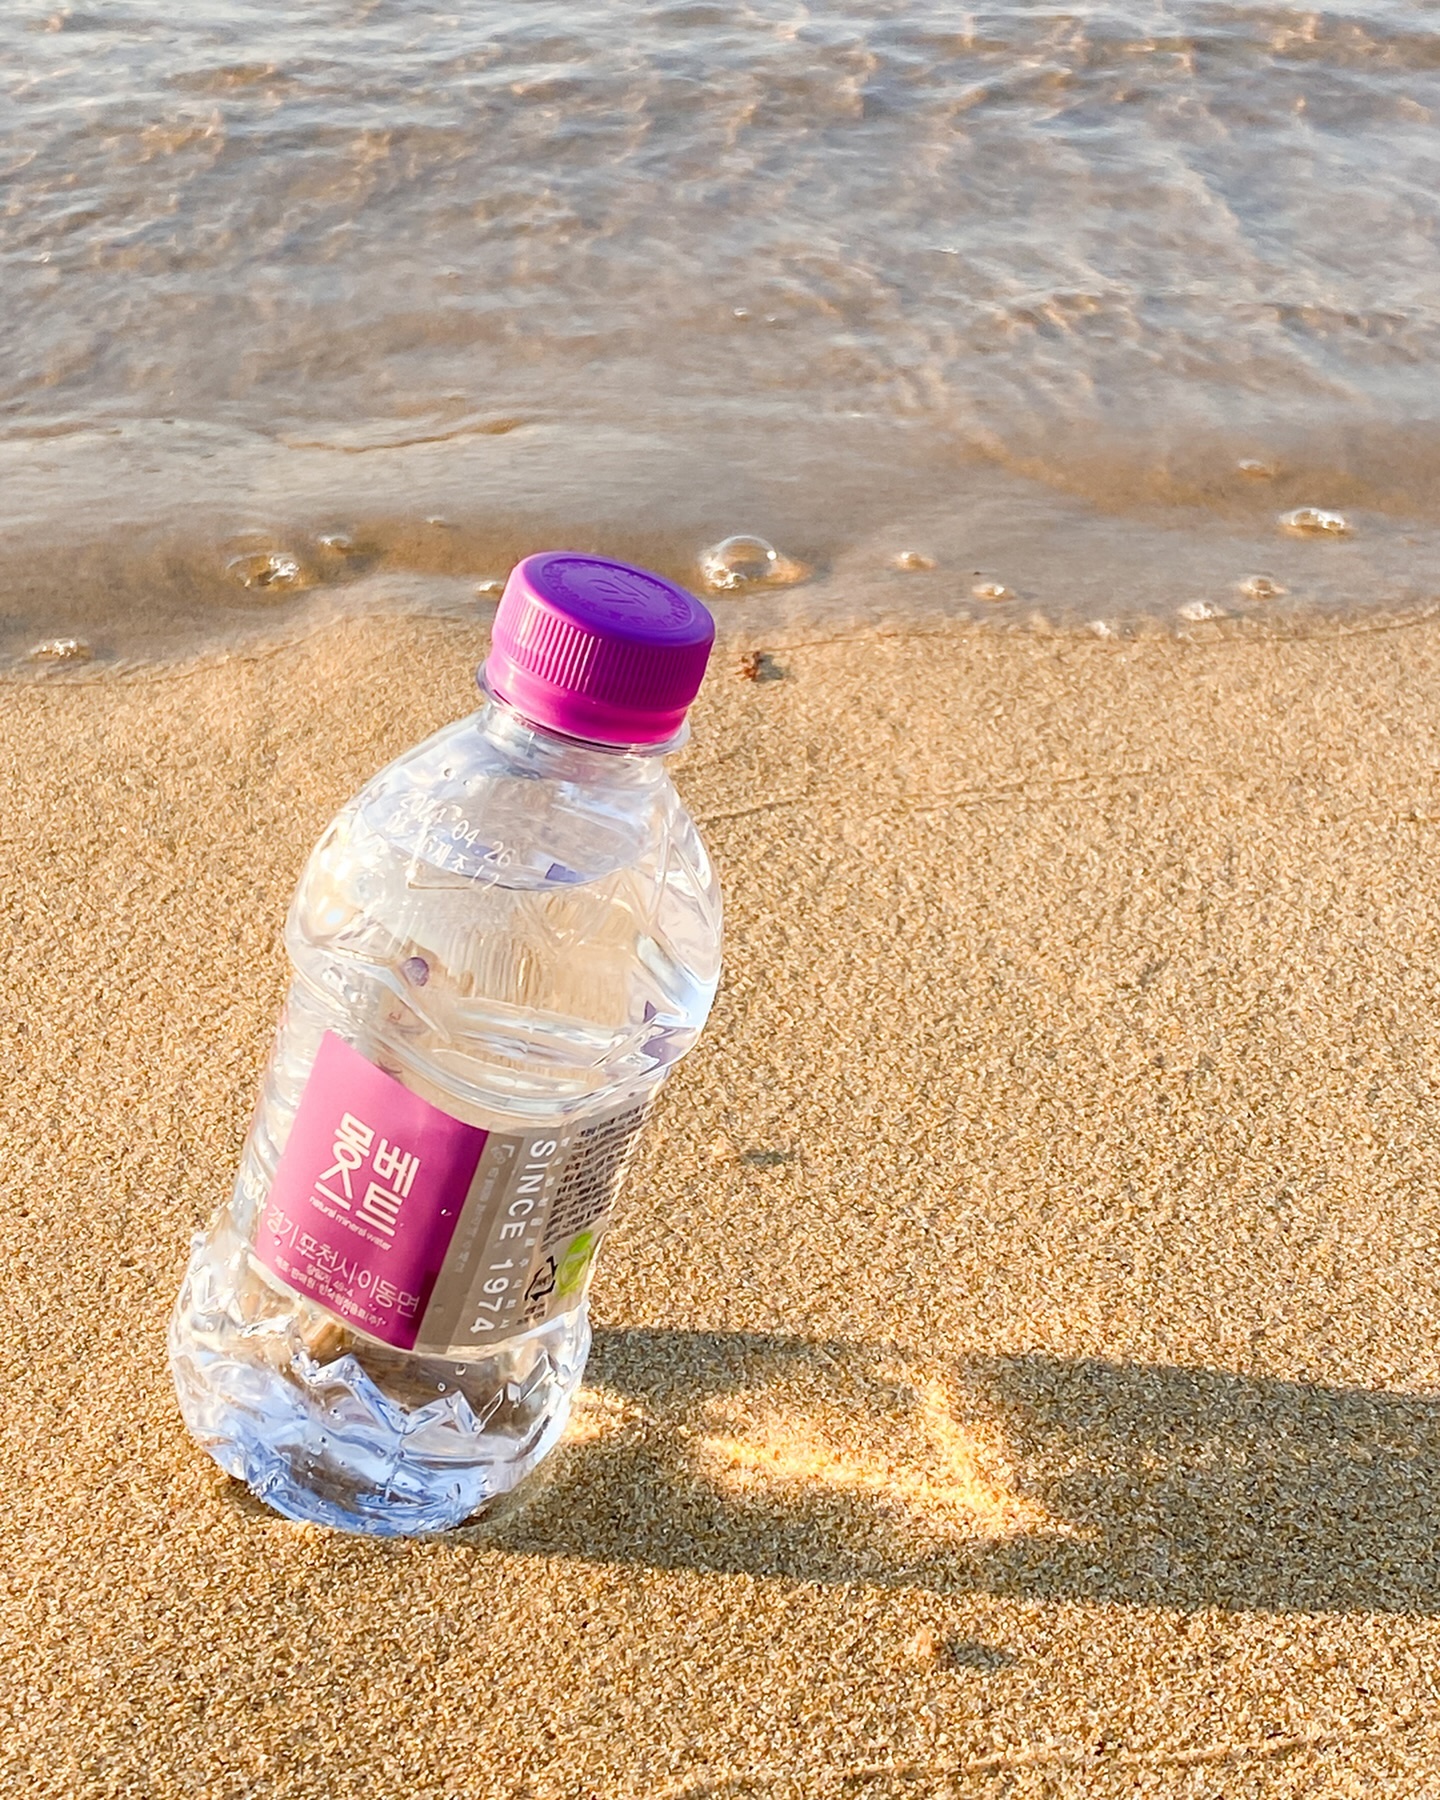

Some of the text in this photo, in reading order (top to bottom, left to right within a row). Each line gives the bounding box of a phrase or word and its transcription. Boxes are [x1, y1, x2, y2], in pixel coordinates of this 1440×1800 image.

[499, 1139, 557, 1240] SINCE
[309, 1195, 392, 1251] natural mineral water
[357, 1269, 420, 1319] 이동면
[470, 1258, 514, 1334] 1974
